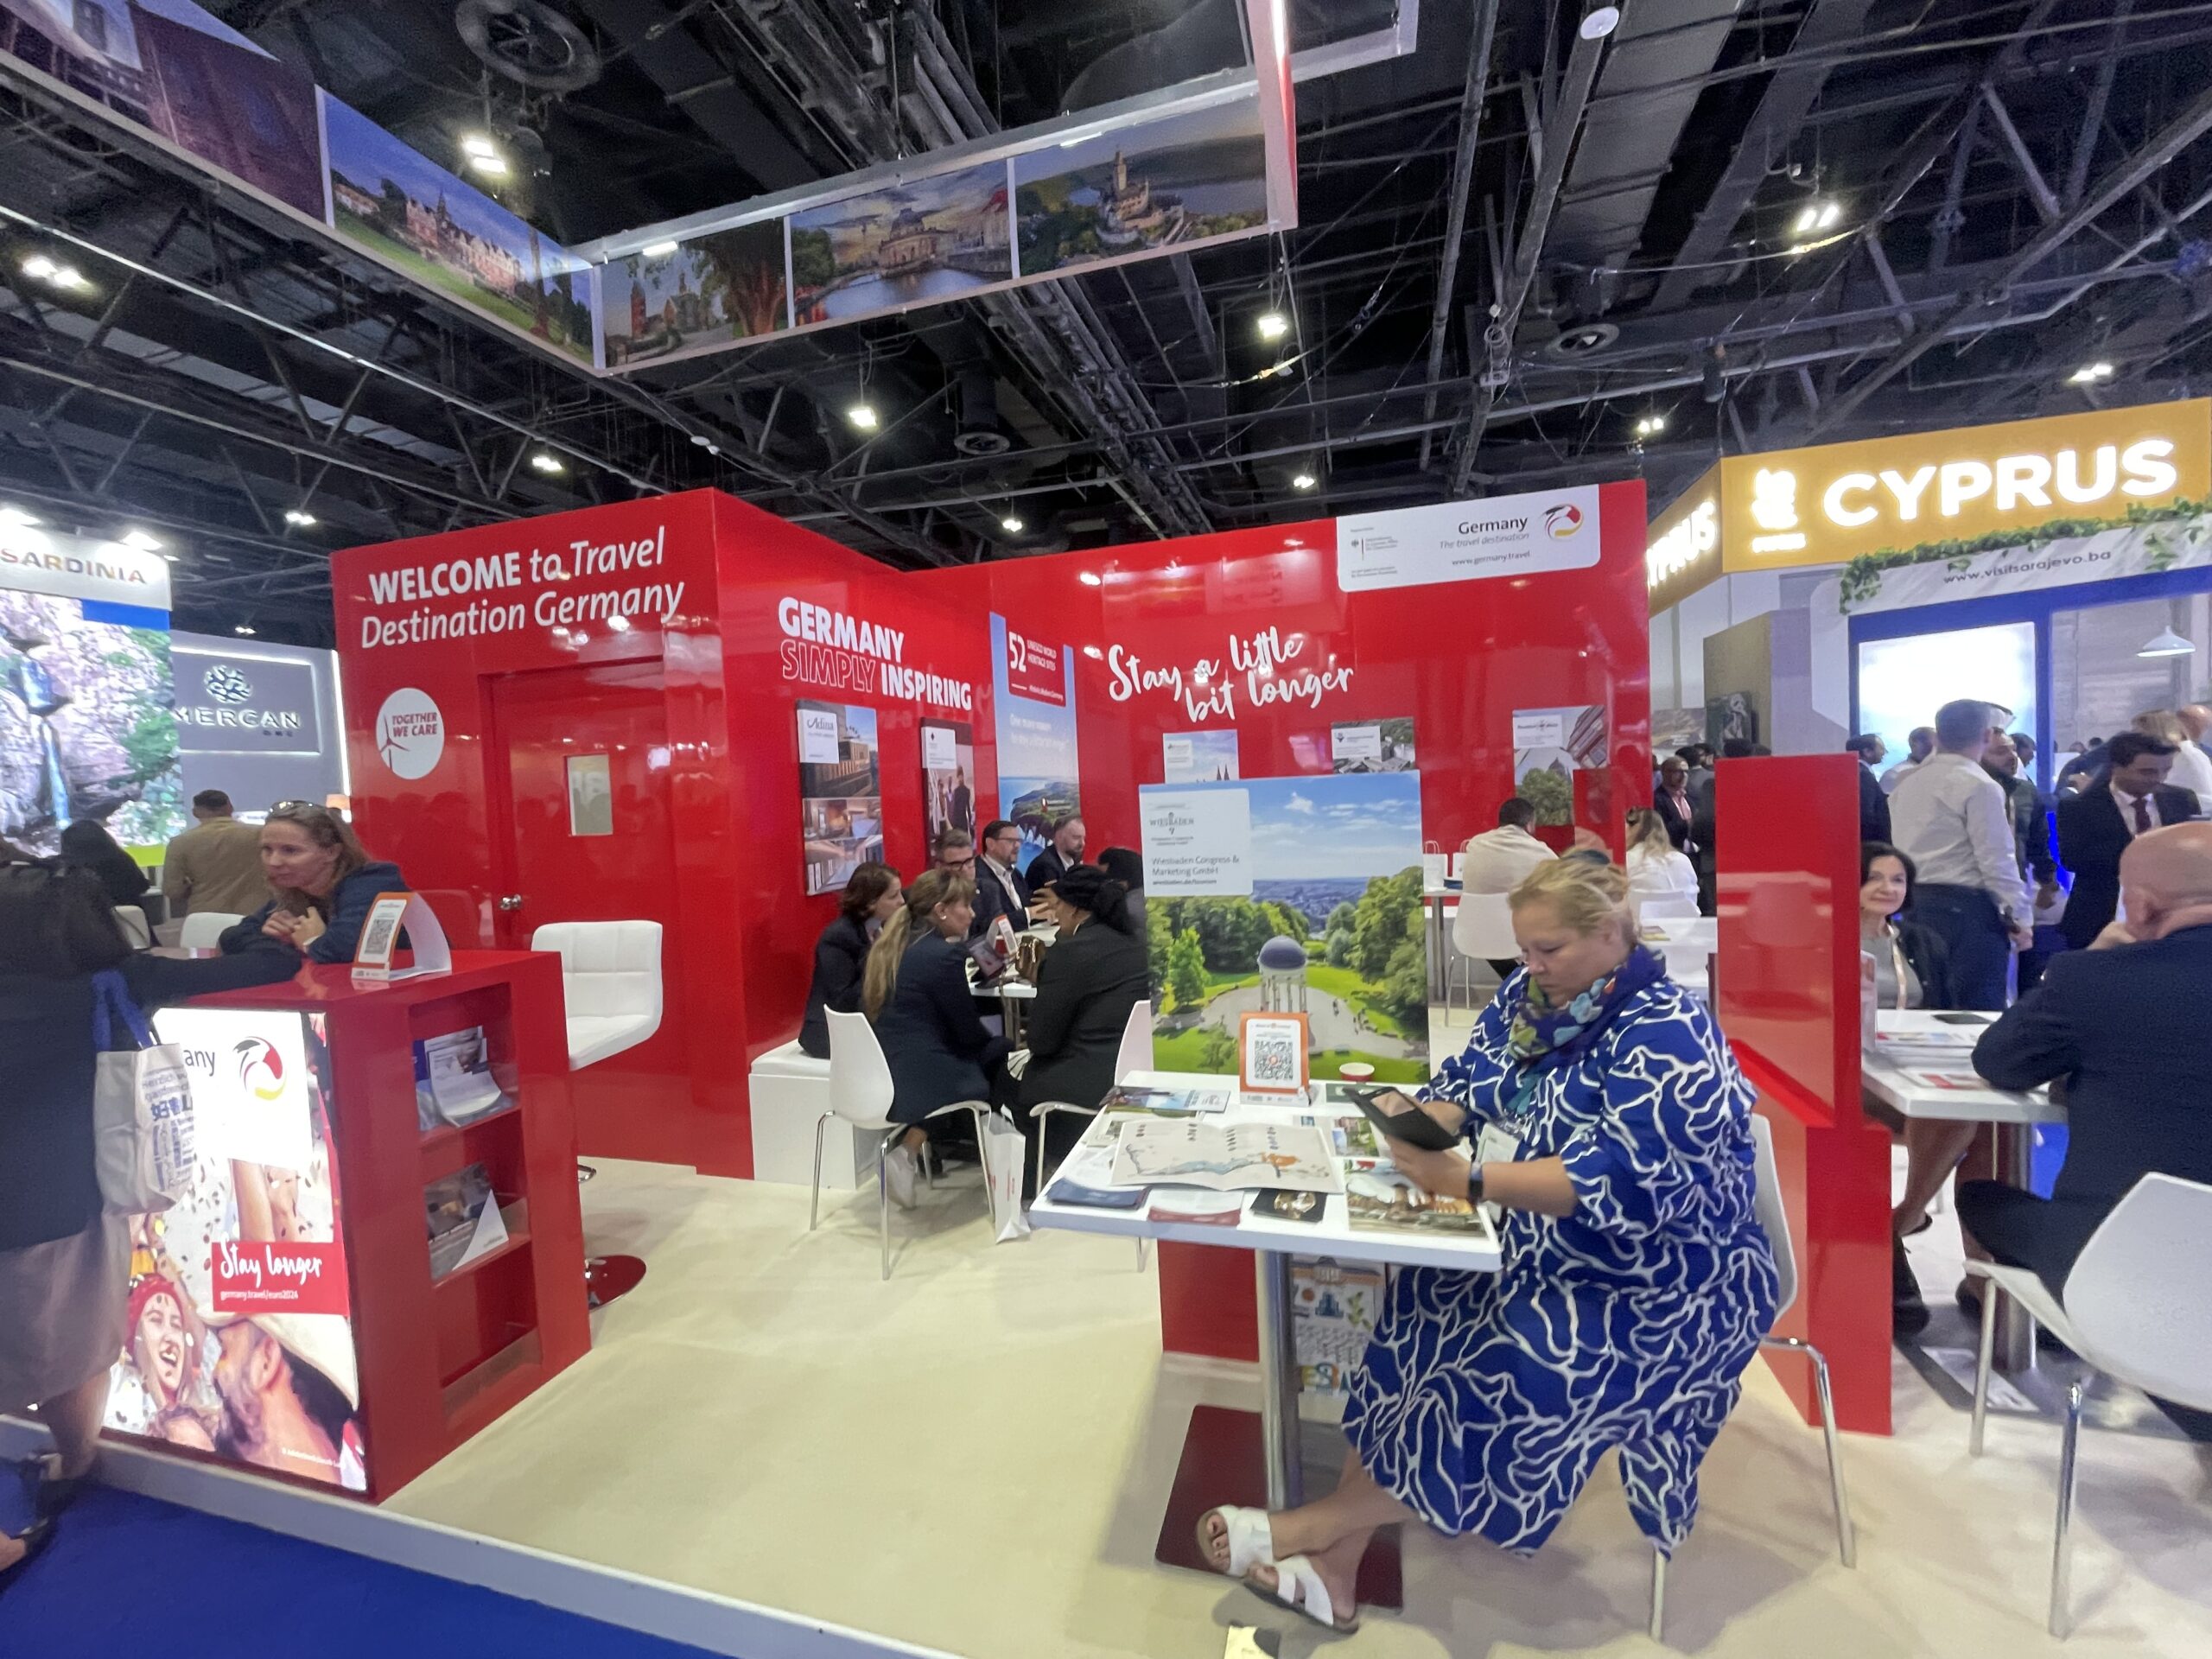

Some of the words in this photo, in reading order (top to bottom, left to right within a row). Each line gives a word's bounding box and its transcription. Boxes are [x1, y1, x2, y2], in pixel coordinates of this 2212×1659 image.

[1822, 439, 2177, 528] CYPRUS
[1439, 540, 1455, 550] The
[1456, 537, 1480, 549] travel
[1480, 532, 1529, 546] destination
[1459, 516, 1529, 535] Germany
[1, 548, 147, 584] SARDINIA
[369, 552, 521, 604] WELCOME
[530, 549, 563, 583] to
[569, 525, 665, 577] Travel
[1452, 550, 1530, 566] www.germany.travel
[1943, 551, 2112, 584] www.visitsarajevo.ba
[361, 598, 525, 649] Destination
[534, 582, 685, 628] Germany
[779, 597, 904, 663] GERMANY
[1008, 632, 1027, 673] 52
[1108, 644, 1182, 702] Stay
[1195, 658, 1220, 685] a
[1230, 626, 1304, 674] little
[779, 639, 876, 694] SIMPLY
[880, 664, 972, 711] INSPIRING
[1185, 683, 1236, 723] bit
[1248, 664, 1353, 709] longer
[391, 712, 437, 725] TOGETHER
[393, 726, 409, 737] WE
[411, 723, 437, 736] CARE
[1152, 868, 1192, 877] Marketing
[1192, 867, 1218, 875] GmbH
[1195, 855, 1230, 865] Congress
[219, 1232, 261, 1288] Stay
[265, 1243, 323, 1286] longer
